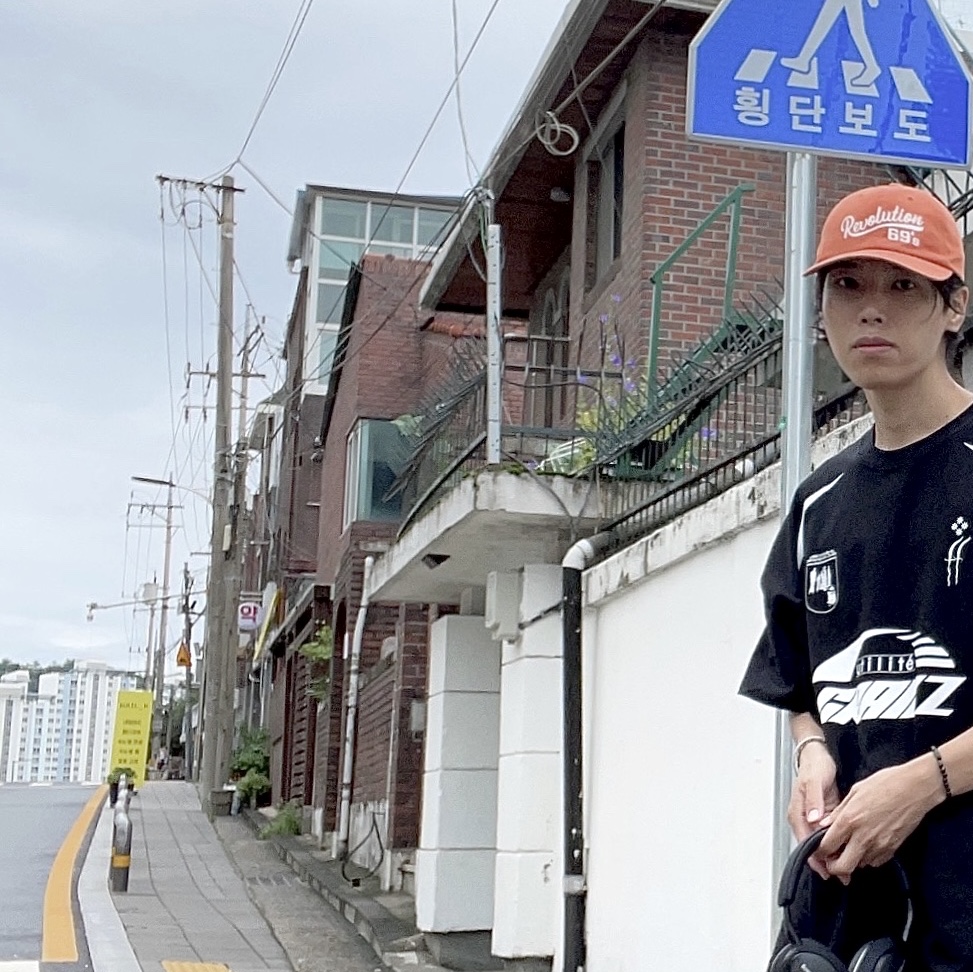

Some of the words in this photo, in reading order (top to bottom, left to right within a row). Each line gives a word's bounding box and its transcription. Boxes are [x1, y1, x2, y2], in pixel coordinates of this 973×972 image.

[733, 86, 932, 142] 횡단보도
[841, 205, 924, 239] Revolution
[887, 228, 920, 247] 69's
